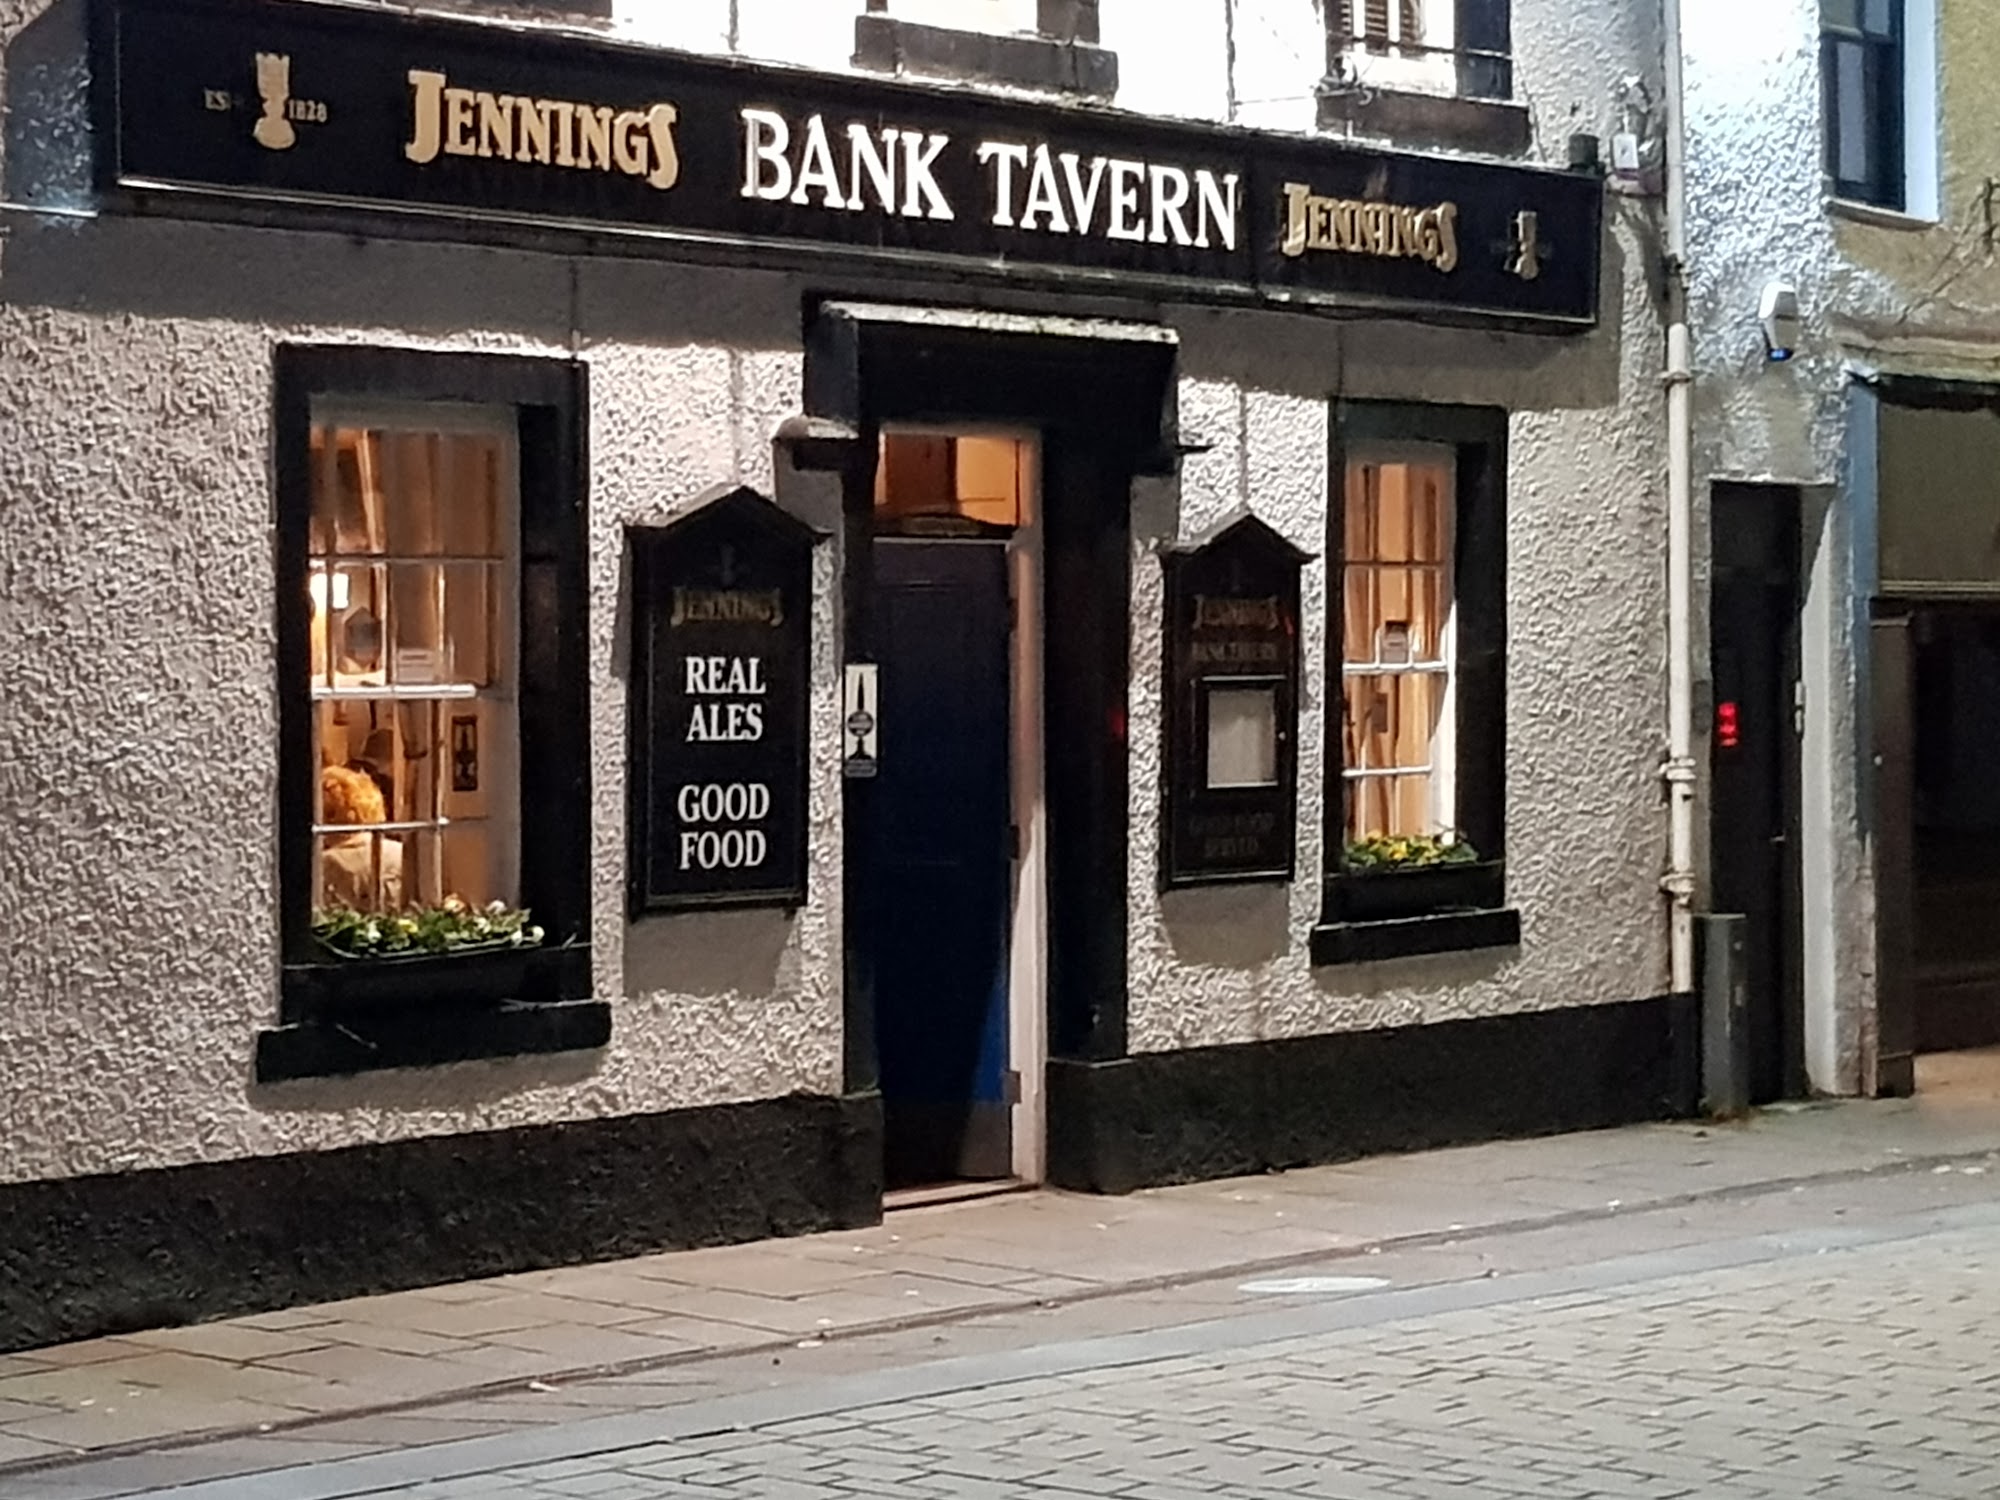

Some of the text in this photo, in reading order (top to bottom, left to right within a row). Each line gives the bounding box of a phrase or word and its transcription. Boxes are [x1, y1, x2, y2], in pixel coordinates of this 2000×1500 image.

[404, 69, 679, 190] JENNINGS
[740, 107, 1239, 252] BANK TAVERN
[1281, 182, 1457, 272] JENNINGS
[685, 656, 766, 694] REAL
[685, 702, 763, 742] ALES
[677, 783, 770, 823] GOOD
[679, 829, 767, 870] FOOD
